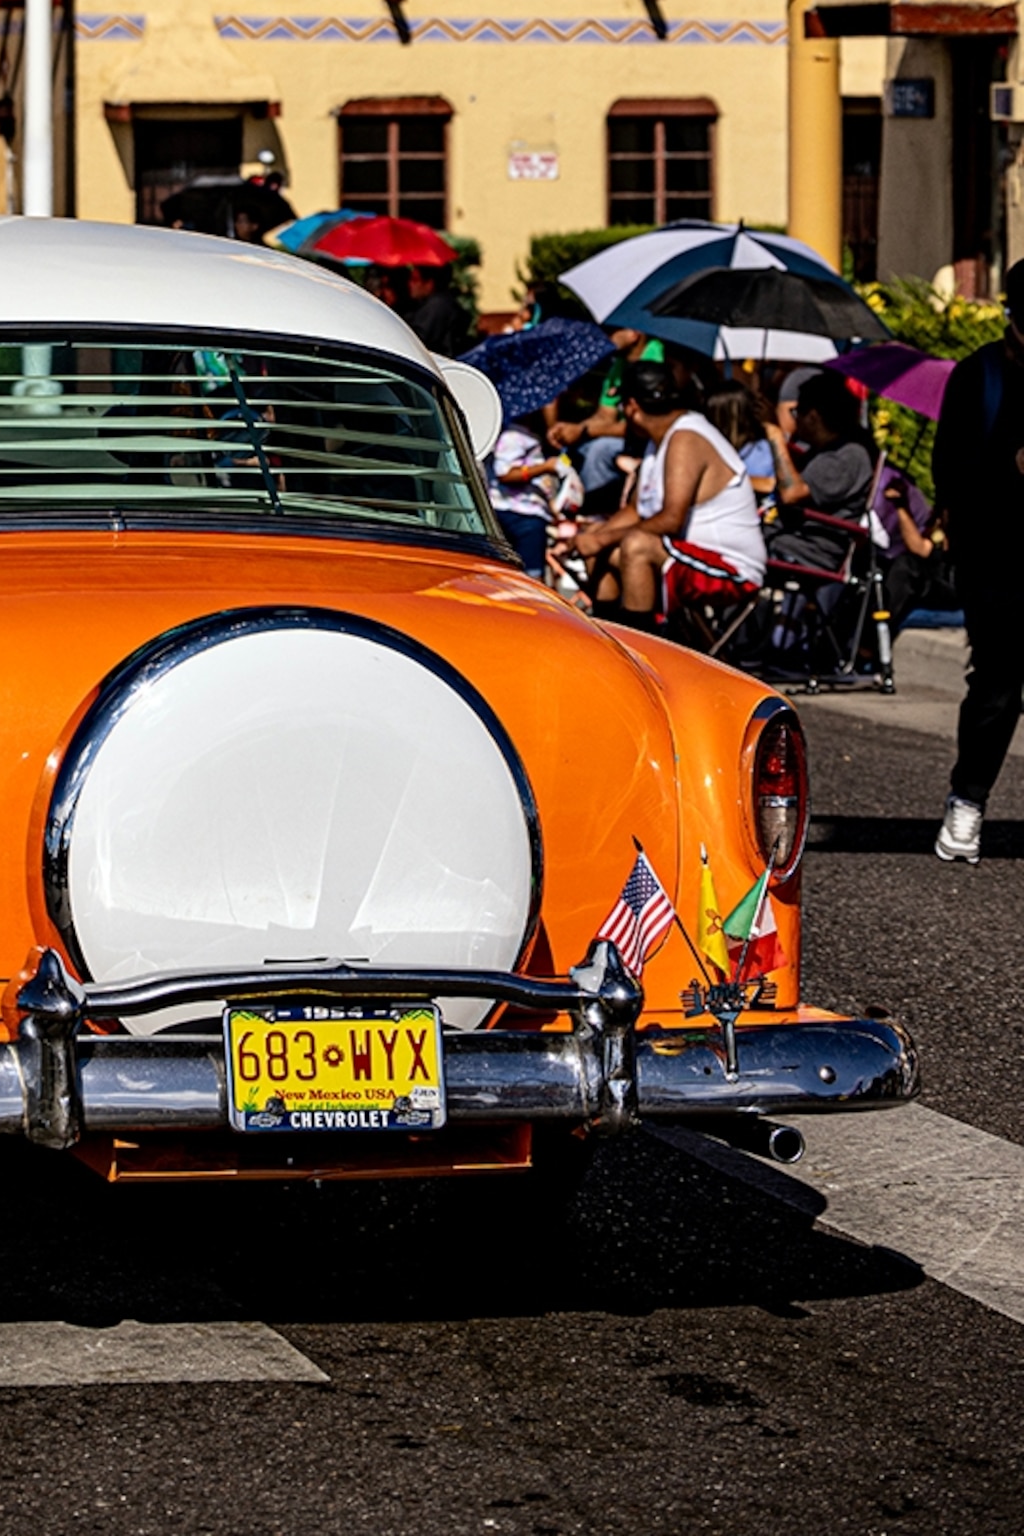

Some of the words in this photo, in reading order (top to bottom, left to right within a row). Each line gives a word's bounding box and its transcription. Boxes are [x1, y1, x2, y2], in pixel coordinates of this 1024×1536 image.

[303, 1006, 363, 1020] 1954
[238, 1030, 317, 1081] 683
[349, 1029, 430, 1081] WYX
[274, 1089, 306, 1100] New
[308, 1089, 361, 1100] Mexico
[364, 1089, 396, 1100] USA
[289, 1110, 390, 1128] CHEVROLET
